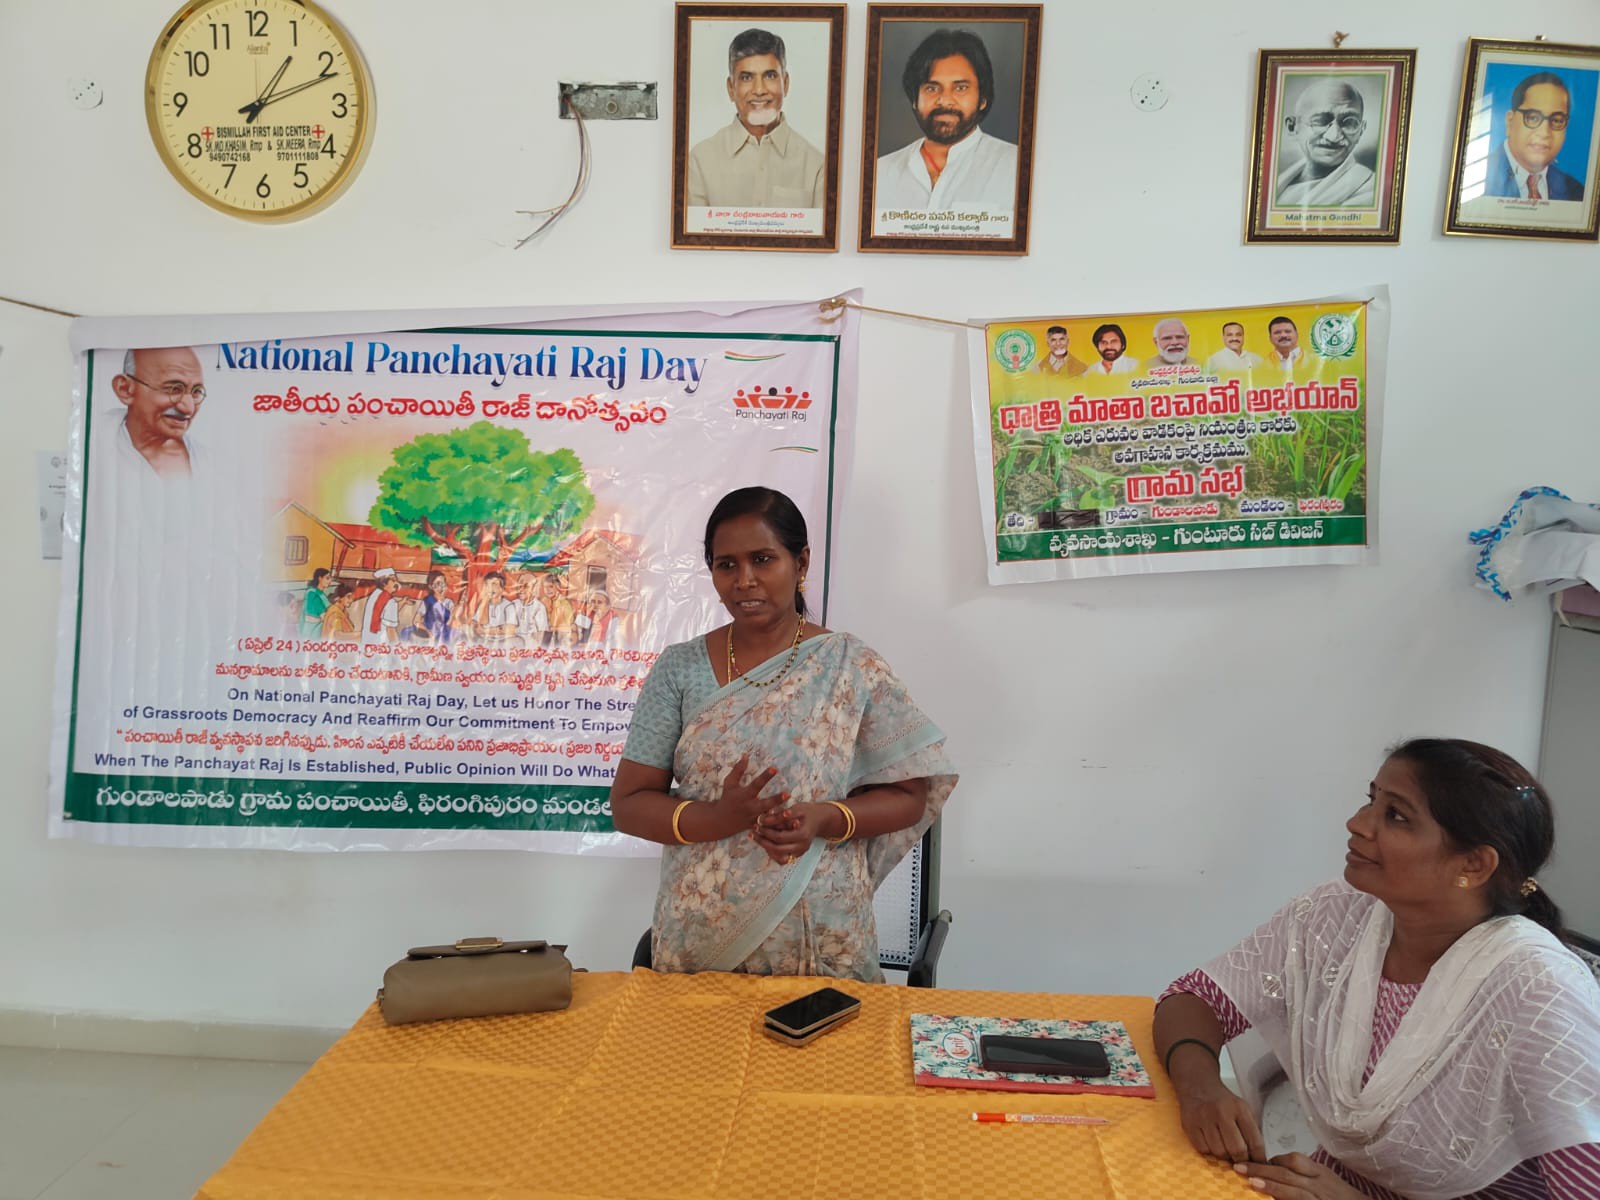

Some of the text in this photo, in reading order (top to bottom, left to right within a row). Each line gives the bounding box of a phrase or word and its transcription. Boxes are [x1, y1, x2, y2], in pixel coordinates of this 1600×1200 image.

[246, 10, 269, 37] 12
[289, 21, 298, 47] 1
[210, 24, 230, 50] 11
[184, 51, 210, 77] 10
[318, 51, 335, 77] 2
[173, 92, 188, 117] 9
[331, 93, 348, 118] 3
[217, 126, 311, 138] BISMILLAH FIRST AID CENTER
[187, 133, 202, 158] 8
[267, 141, 272, 150] &
[320, 133, 336, 158] 4
[221, 164, 237, 189] 7
[256, 174, 270, 198] 6
[294, 163, 309, 188] 5
[216, 340, 708, 394] National Panchayati Raj Day
[252, 387, 340, 414] జాతీయ
[346, 390, 475, 416] పంచాయితీ
[481, 394, 531, 418] రాజ్
[1068, 394, 1144, 424] మాతా
[1151, 379, 1240, 418] బచావో
[735, 409, 807, 422] Panchayati Raj
[1063, 430, 1092, 447] అధిక
[1096, 429, 1139, 442] ఎరువల
[1114, 446, 1172, 463] అవగాహన
[1127, 465, 1243, 504] గ్రామ సభ
[1174, 525, 1246, 544] గుంటూరు
[1250, 522, 1277, 541] సబ్
[276, 640, 293, 652] 24
[364, 643, 391, 658] గ్రామ
[228, 688, 636, 711] On National Panchayati Raj Day, Let us Honor The Stre
[124, 706, 632, 734] of Grassroots Democracy And Reaffirm Our Commitment To Empo
[95, 753, 615, 778] When The Panchayat Raj Is Established, Public Opinion Will Do What
[96, 786, 235, 808] గుండాలపాడు
[239, 791, 291, 816] గ్రామ
[418, 794, 537, 817] ఫిరంగిపురం
[542, 798, 613, 817] మండల
